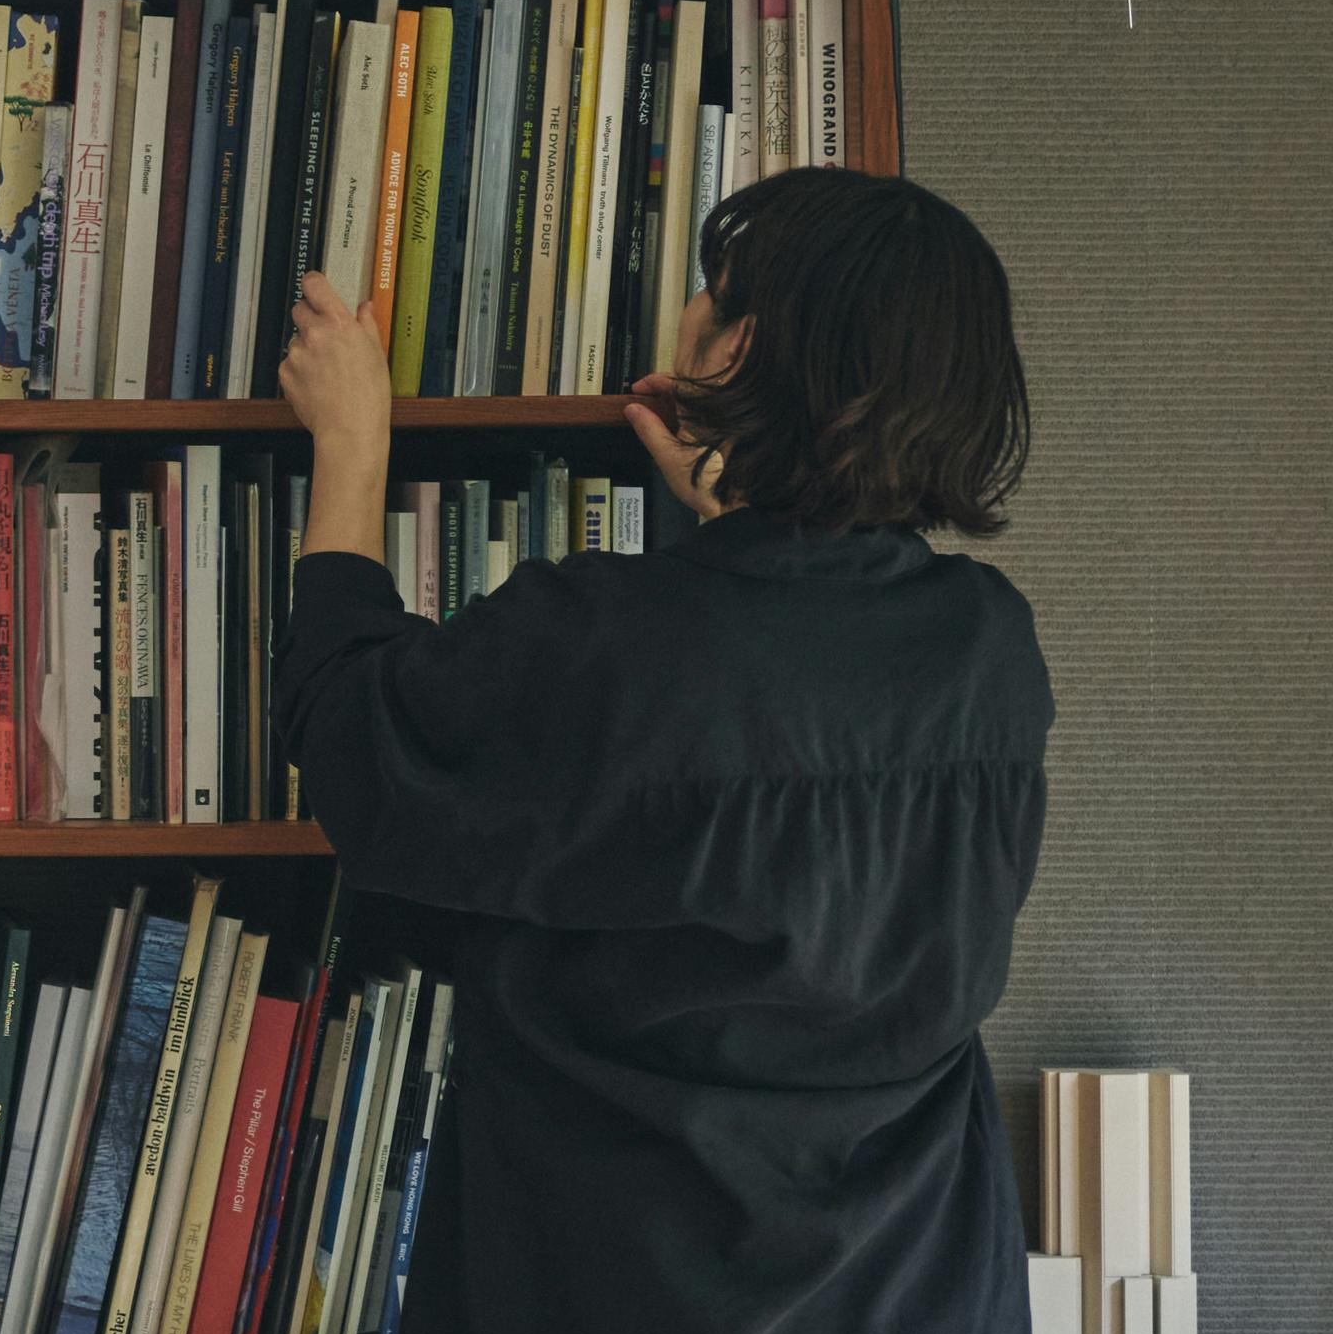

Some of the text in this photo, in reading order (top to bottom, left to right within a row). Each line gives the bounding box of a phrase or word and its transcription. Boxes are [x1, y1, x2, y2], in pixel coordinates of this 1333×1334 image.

[395, 43, 411, 97] ALEC SOTH
[740, 65, 752, 156] KIPUKA
[822, 43, 836, 156] WINOGRAND
[379, 151, 402, 289] ADVICE FOR YOUNG ARTISTS
[411, 164, 432, 243] Songbook
[540, 106, 560, 258] THE DYNAMICS OF DUST
[232, 1087, 267, 1212] The Pillar Stephen Gill
